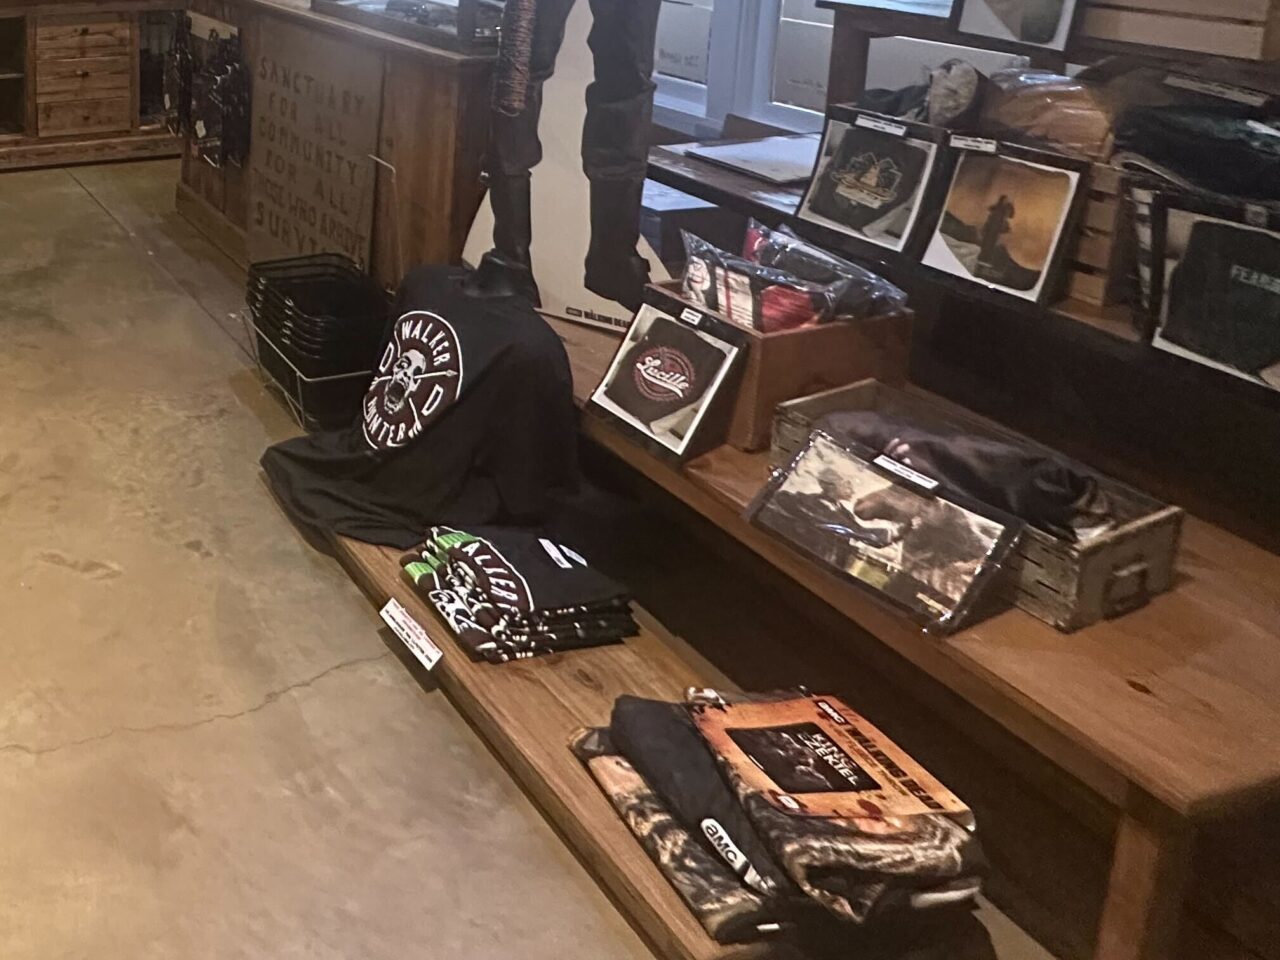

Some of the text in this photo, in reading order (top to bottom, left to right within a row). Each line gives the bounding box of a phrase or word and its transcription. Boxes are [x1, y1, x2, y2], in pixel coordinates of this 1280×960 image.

[259, 56, 365, 116] SANCTUARY
[269, 91, 297, 123] FOR
[258, 115, 358, 185] COMMUNITY
[265, 150, 349, 216] FOR ALL
[255, 201, 318, 257] SURVI
[379, 342, 395, 373] D
[402, 320, 451, 367] WALKER
[636, 356, 689, 392] Lucille
[421, 384, 444, 416] D
[462, 541, 519, 601] ALKER
[811, 732, 858, 770] KING
[845, 725, 946, 810] WALKING DEAD
